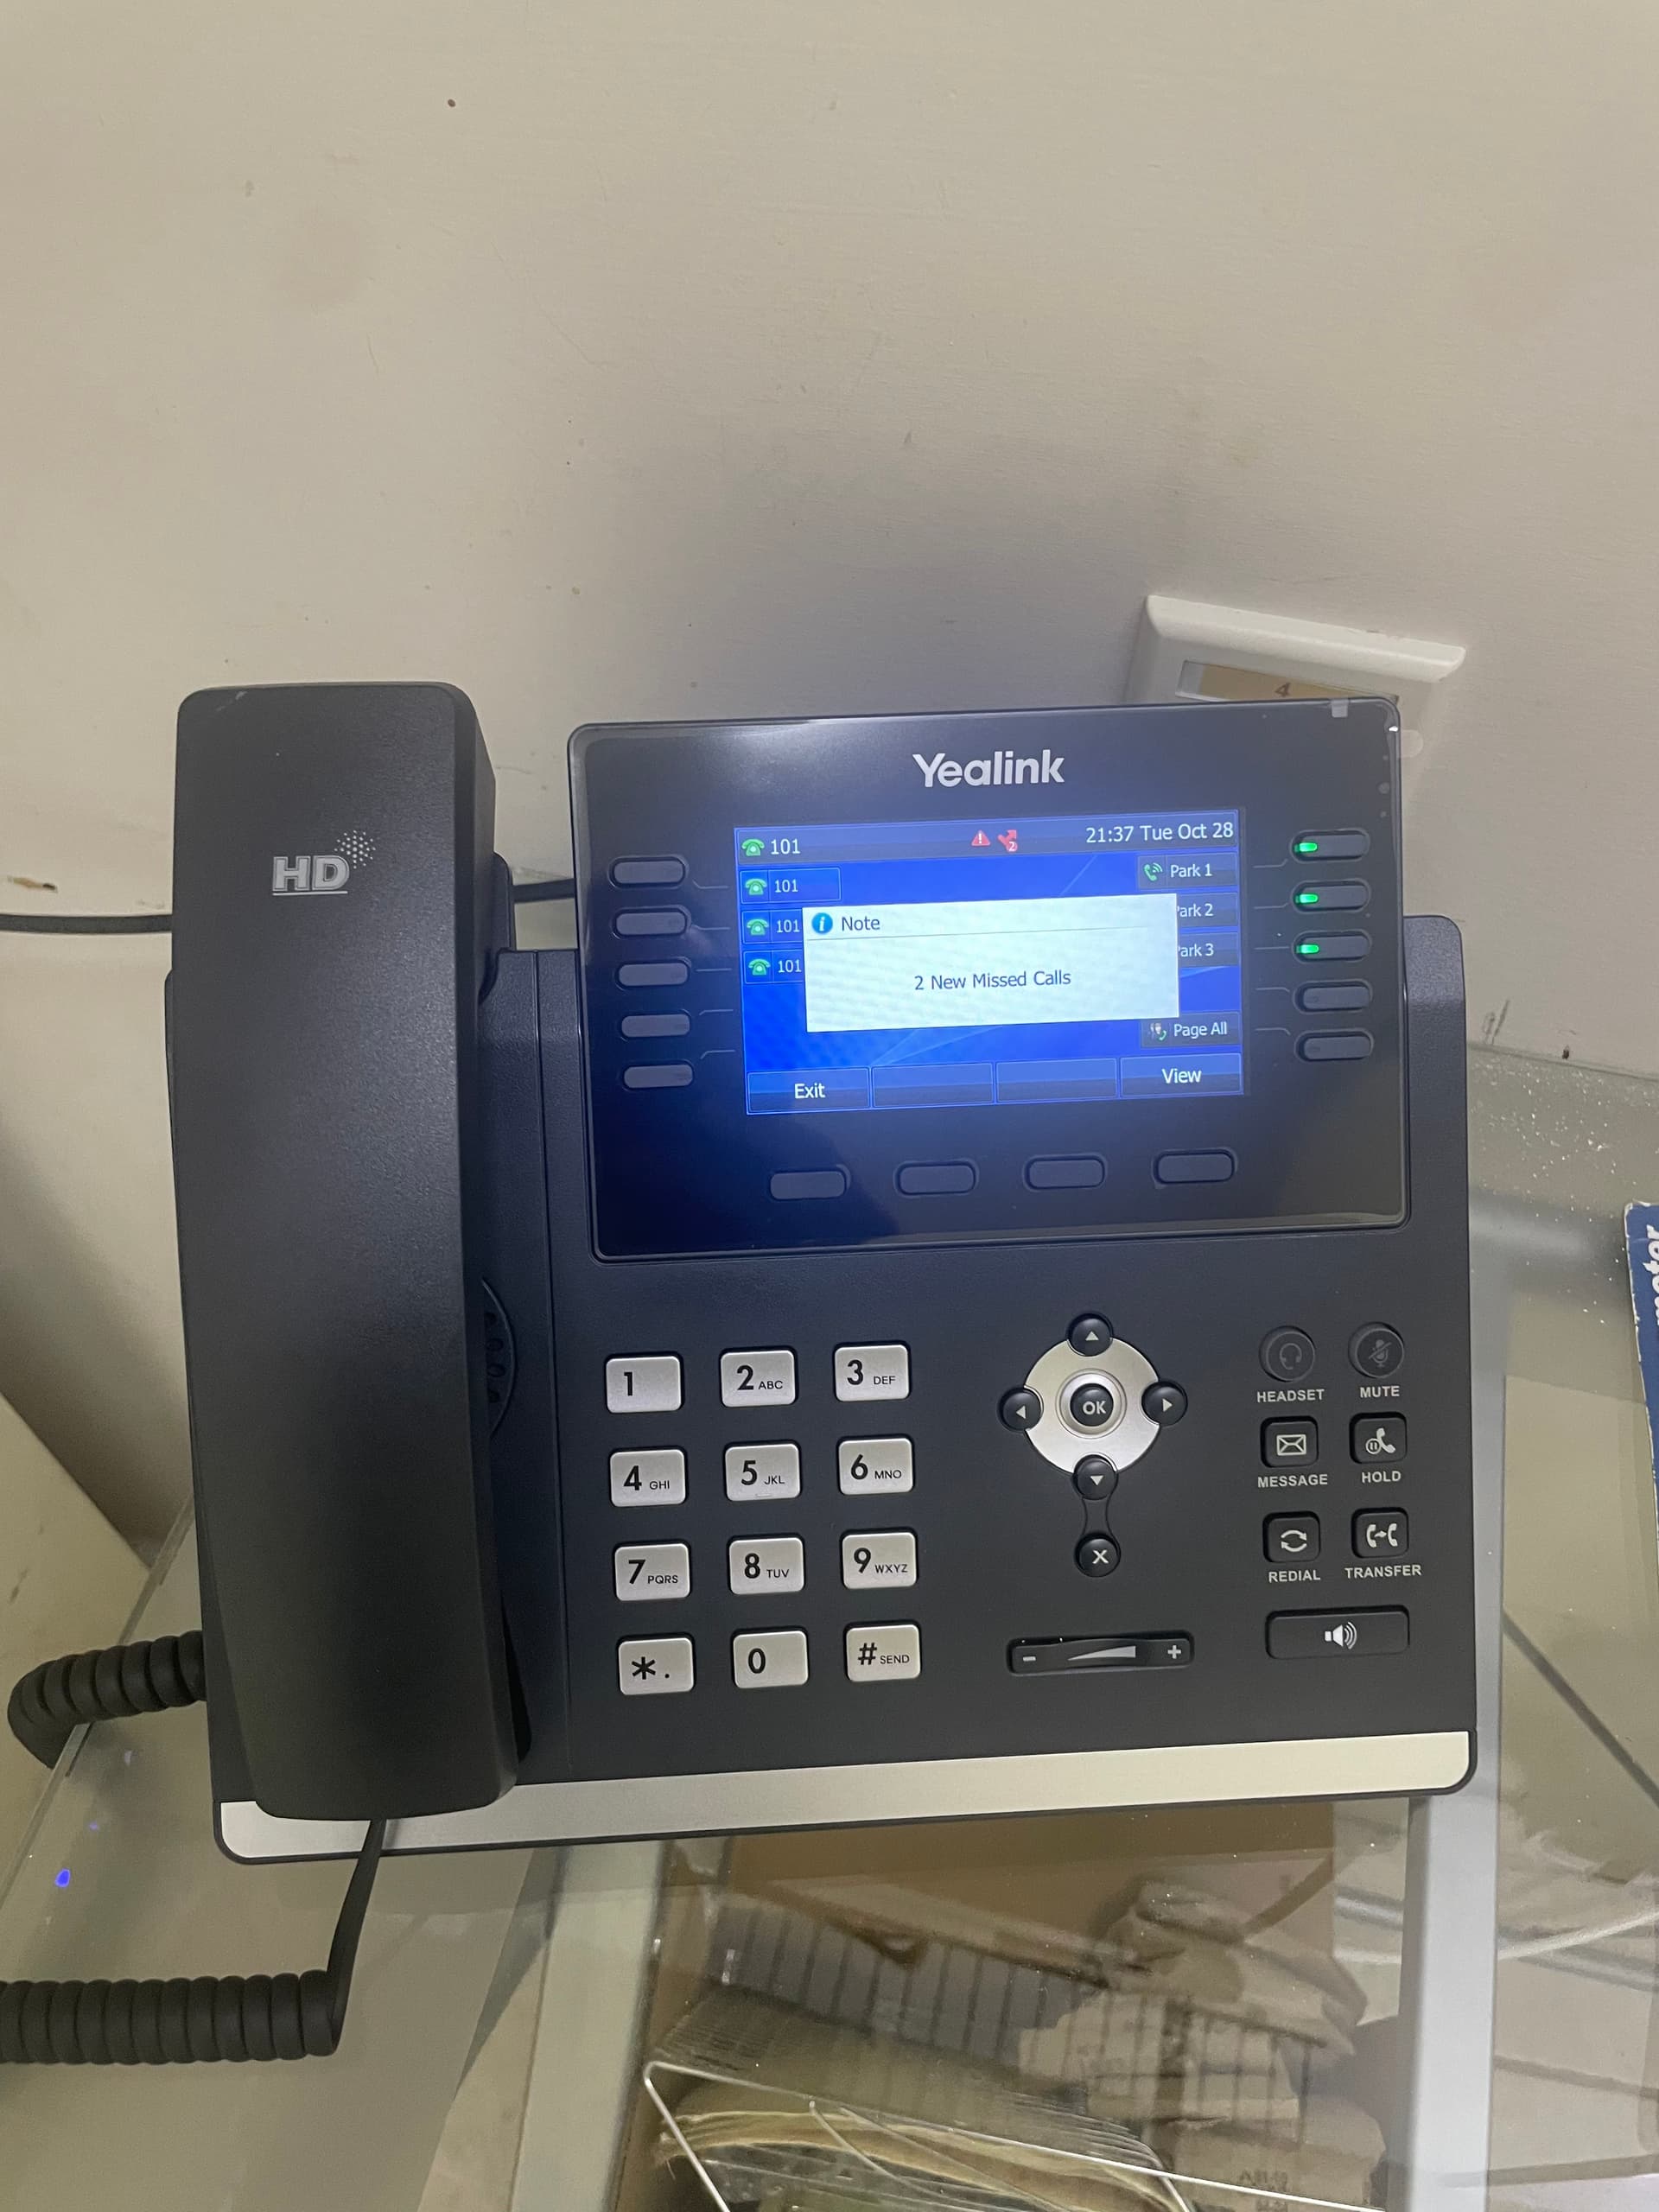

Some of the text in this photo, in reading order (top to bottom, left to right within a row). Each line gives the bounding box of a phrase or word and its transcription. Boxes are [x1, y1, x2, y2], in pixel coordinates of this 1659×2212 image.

[912, 749, 1065, 788] Yealink
[1086, 822, 1234, 843] 21:37 Tue Oct 28
[771, 838, 801, 855] 101
[272, 855, 350, 892] HD
[1170, 863, 1212, 878] Park 1
[775, 879, 798, 893] 101
[1177, 903, 1214, 918] ark 2
[776, 918, 800, 933] 101
[842, 916, 880, 931] Note
[1178, 943, 1214, 957] ark 3
[778, 958, 802, 973] 101
[914, 969, 1071, 990] 2 New Missed Calls
[1173, 1020, 1228, 1039] Page All
[1161, 1068, 1202, 1084] View
[794, 1083, 826, 1099] Exit
[736, 1364, 784, 1391] 2 ABC
[847, 1359, 896, 1386] 3 DEF
[623, 1371, 633, 1396] 1
[1360, 1385, 1400, 1398] MUTE
[1256, 1389, 1325, 1403] HEADSET
[1083, 1400, 1107, 1415] OK
[741, 1459, 785, 1486] 5 JKL
[850, 1453, 902, 1480] 6 MNO
[623, 1465, 671, 1491] 4 GHI
[1257, 1473, 1328, 1488] MESSAGE
[1361, 1471, 1402, 1484] HOLD
[744, 1553, 790, 1580] 8 TUV
[853, 1547, 908, 1573] 9 WXYZ
[628, 1559, 678, 1585] 7 PQRS
[1268, 1569, 1321, 1584] REDIAL
[1344, 1564, 1422, 1579] TRANSFER
[747, 1648, 766, 1675] 0
[880, 1654, 910, 1665] SEND
